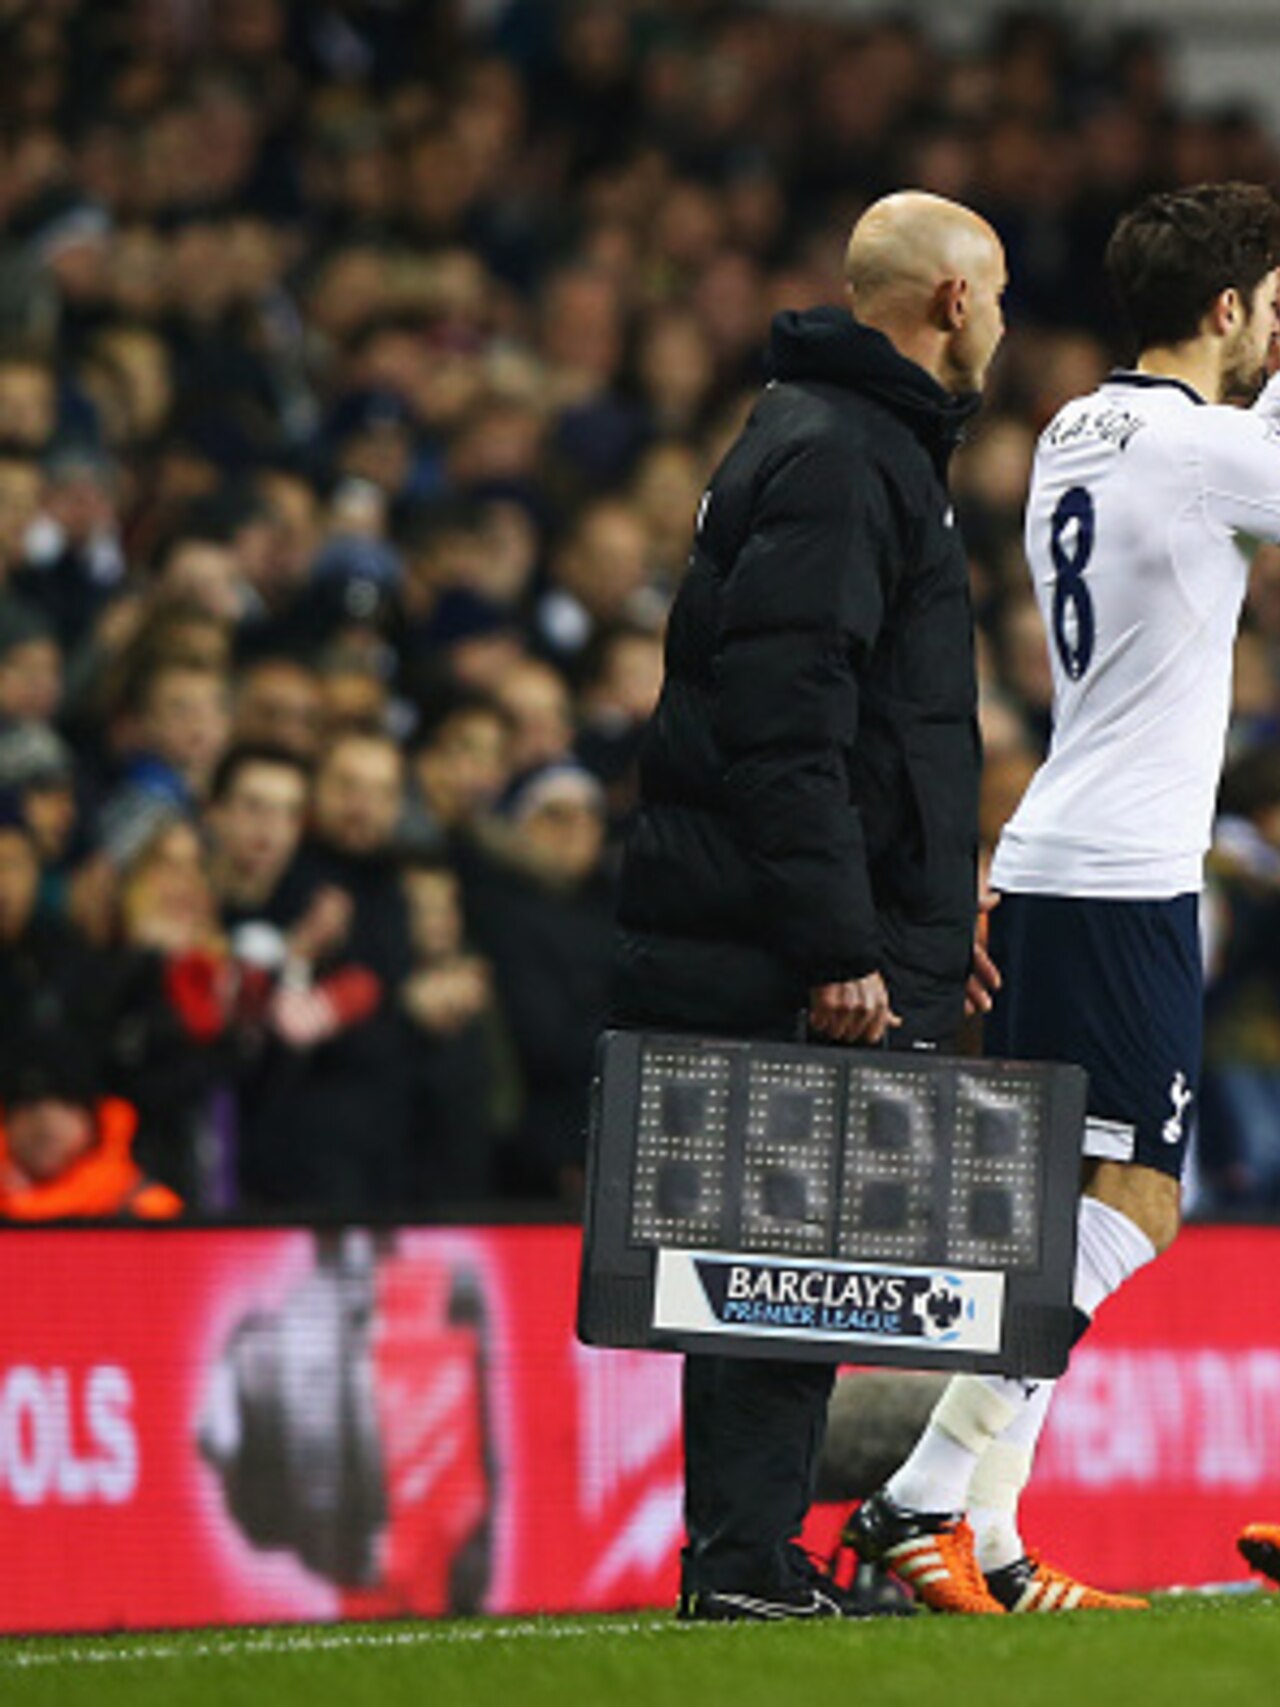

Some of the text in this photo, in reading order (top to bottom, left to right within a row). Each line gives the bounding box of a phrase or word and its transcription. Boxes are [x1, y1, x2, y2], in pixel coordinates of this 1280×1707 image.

[1050, 485, 1096, 683] 8
[726, 1266, 907, 1311] BARCLAYS
[722, 1300, 903, 1333] PREMIER LEAGUE
